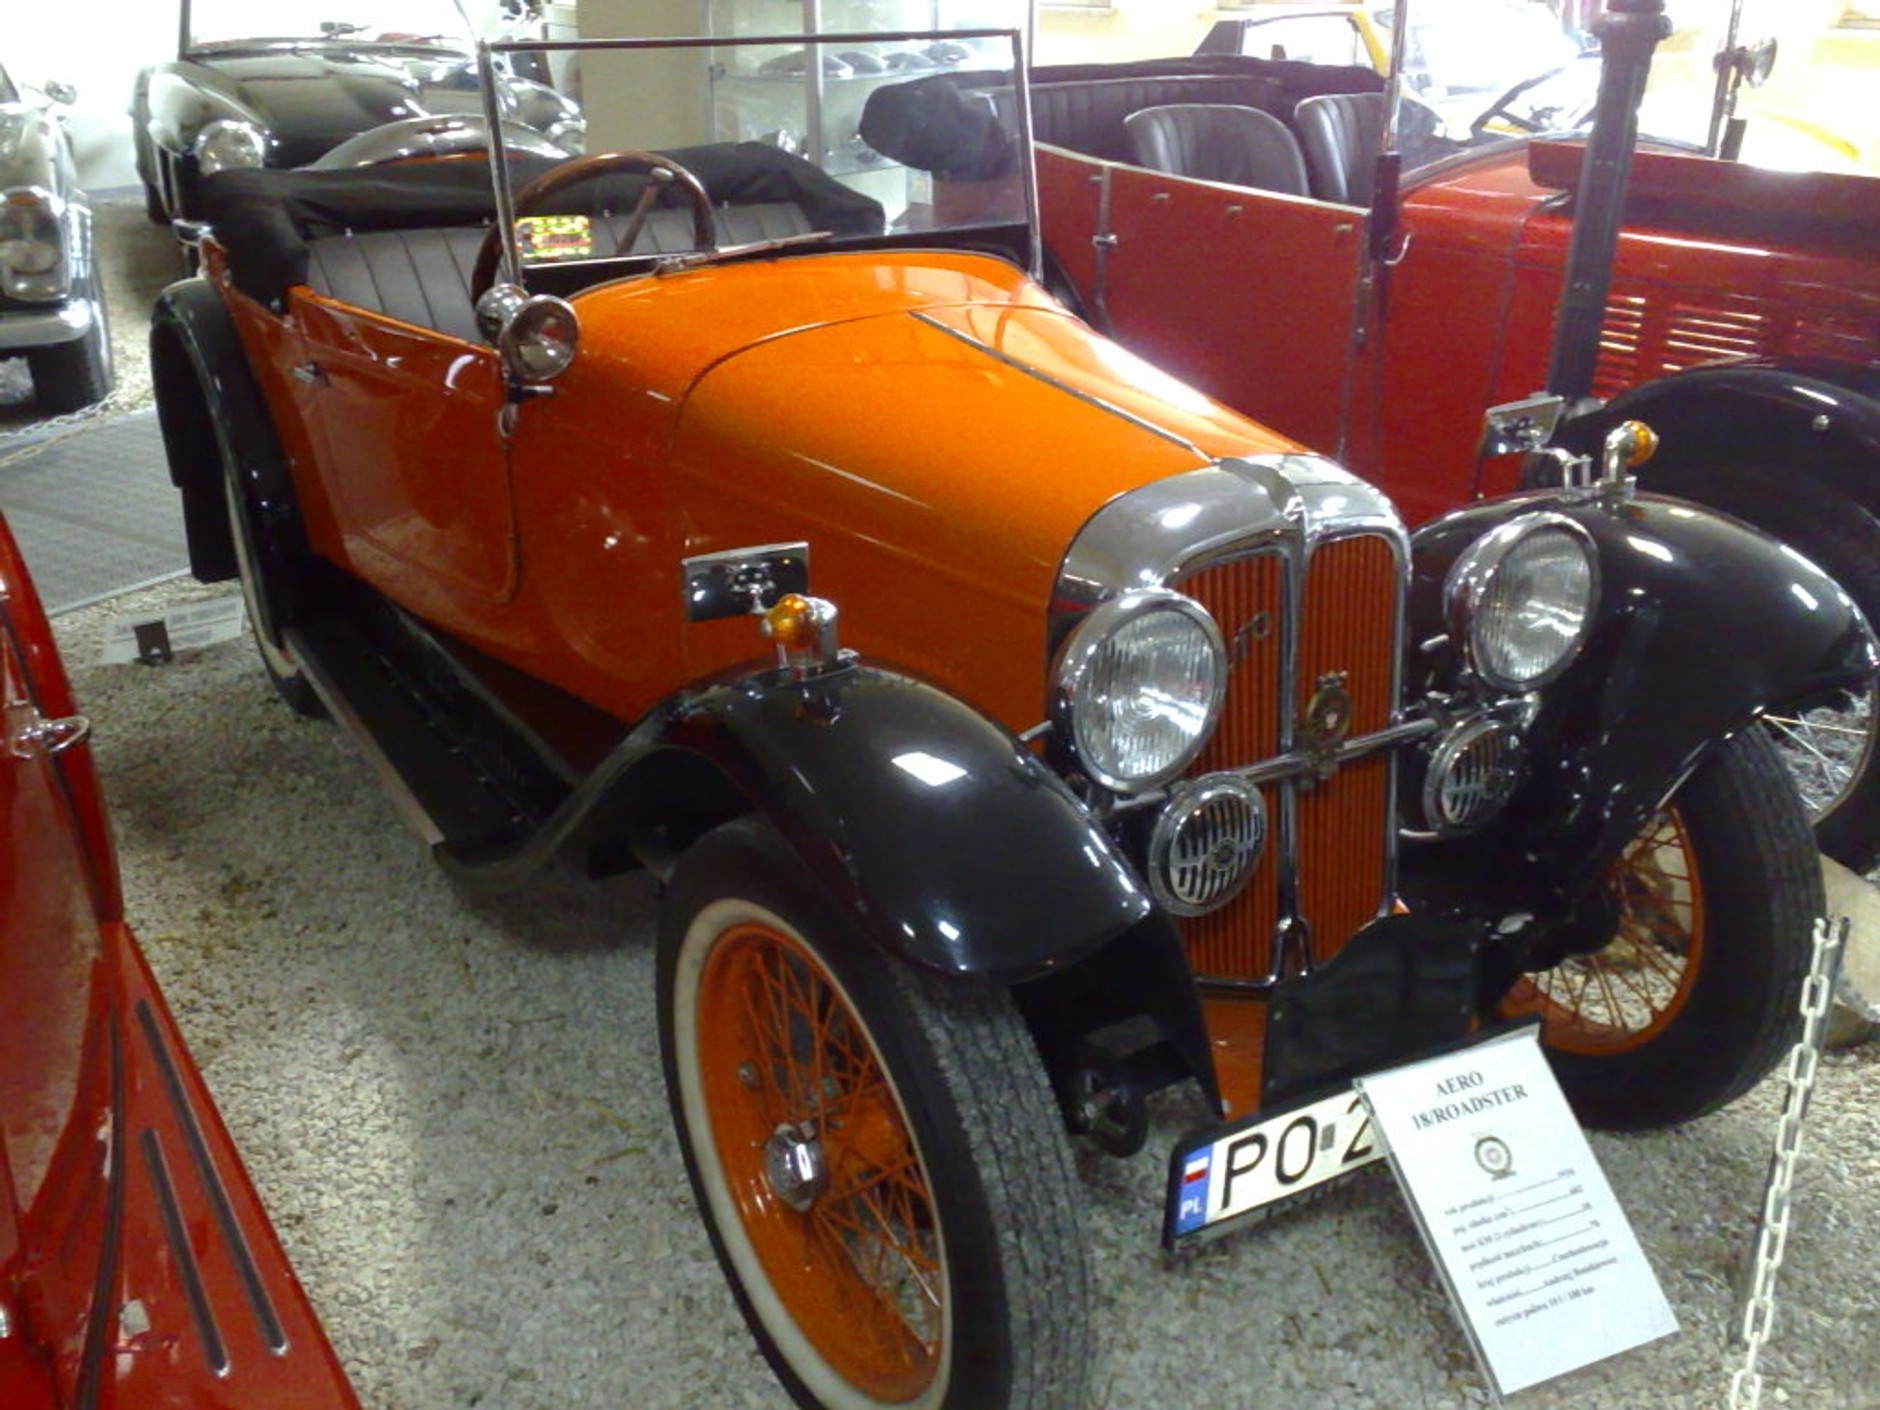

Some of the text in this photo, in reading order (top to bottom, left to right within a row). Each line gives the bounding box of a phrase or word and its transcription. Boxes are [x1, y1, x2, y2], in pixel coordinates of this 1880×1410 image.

[1436, 1070, 1484, 1097] AERO
[1412, 1084, 1529, 1130] 18/ROADSTER
[1180, 1196, 1202, 1220] PL
